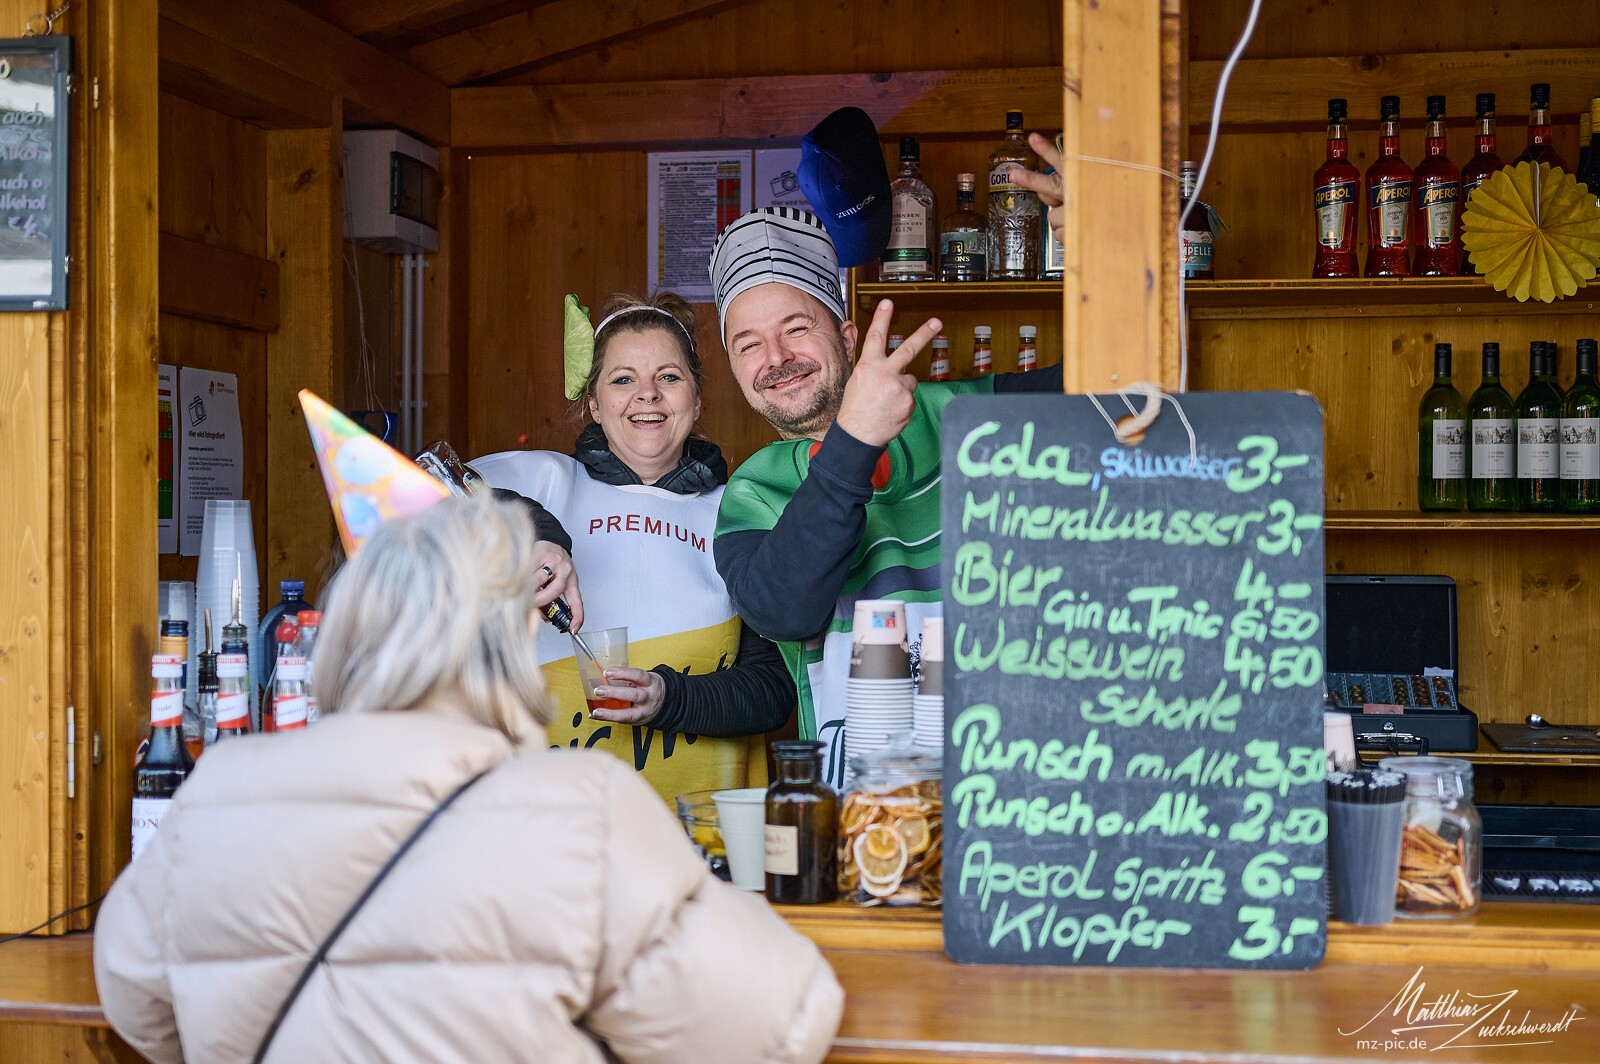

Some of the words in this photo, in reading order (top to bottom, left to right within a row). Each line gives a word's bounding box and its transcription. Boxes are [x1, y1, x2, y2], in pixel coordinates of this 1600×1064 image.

[2, 102, 44, 126] auch
[1314, 187, 1351, 205] APEROL
[1100, 447, 1242, 480] Skiwasser
[589, 513, 706, 553] PREMIUM
[962, 485, 1265, 547] Mineralwasser
[952, 541, 1063, 608] Bier
[1043, 589, 1104, 634] Gin
[1107, 605, 1142, 634] u.
[1128, 586, 1224, 640] Tonic
[1231, 607, 1320, 643] 6,50
[953, 618, 1185, 683] Weisswein
[1224, 632, 1323, 694] 4,50
[1080, 678, 1242, 733] Schorle
[951, 703, 1113, 782] Punsch
[1172, 747, 1244, 789] Alk.
[1244, 738, 1327, 797] 3,50
[951, 773, 1094, 837] Punsch
[1096, 812, 1134, 838] o.
[1135, 792, 1221, 839] Alk.
[1228, 791, 1329, 845] 2,50
[1112, 849, 1228, 906] Spritz
[988, 900, 1192, 963] Klopfer
